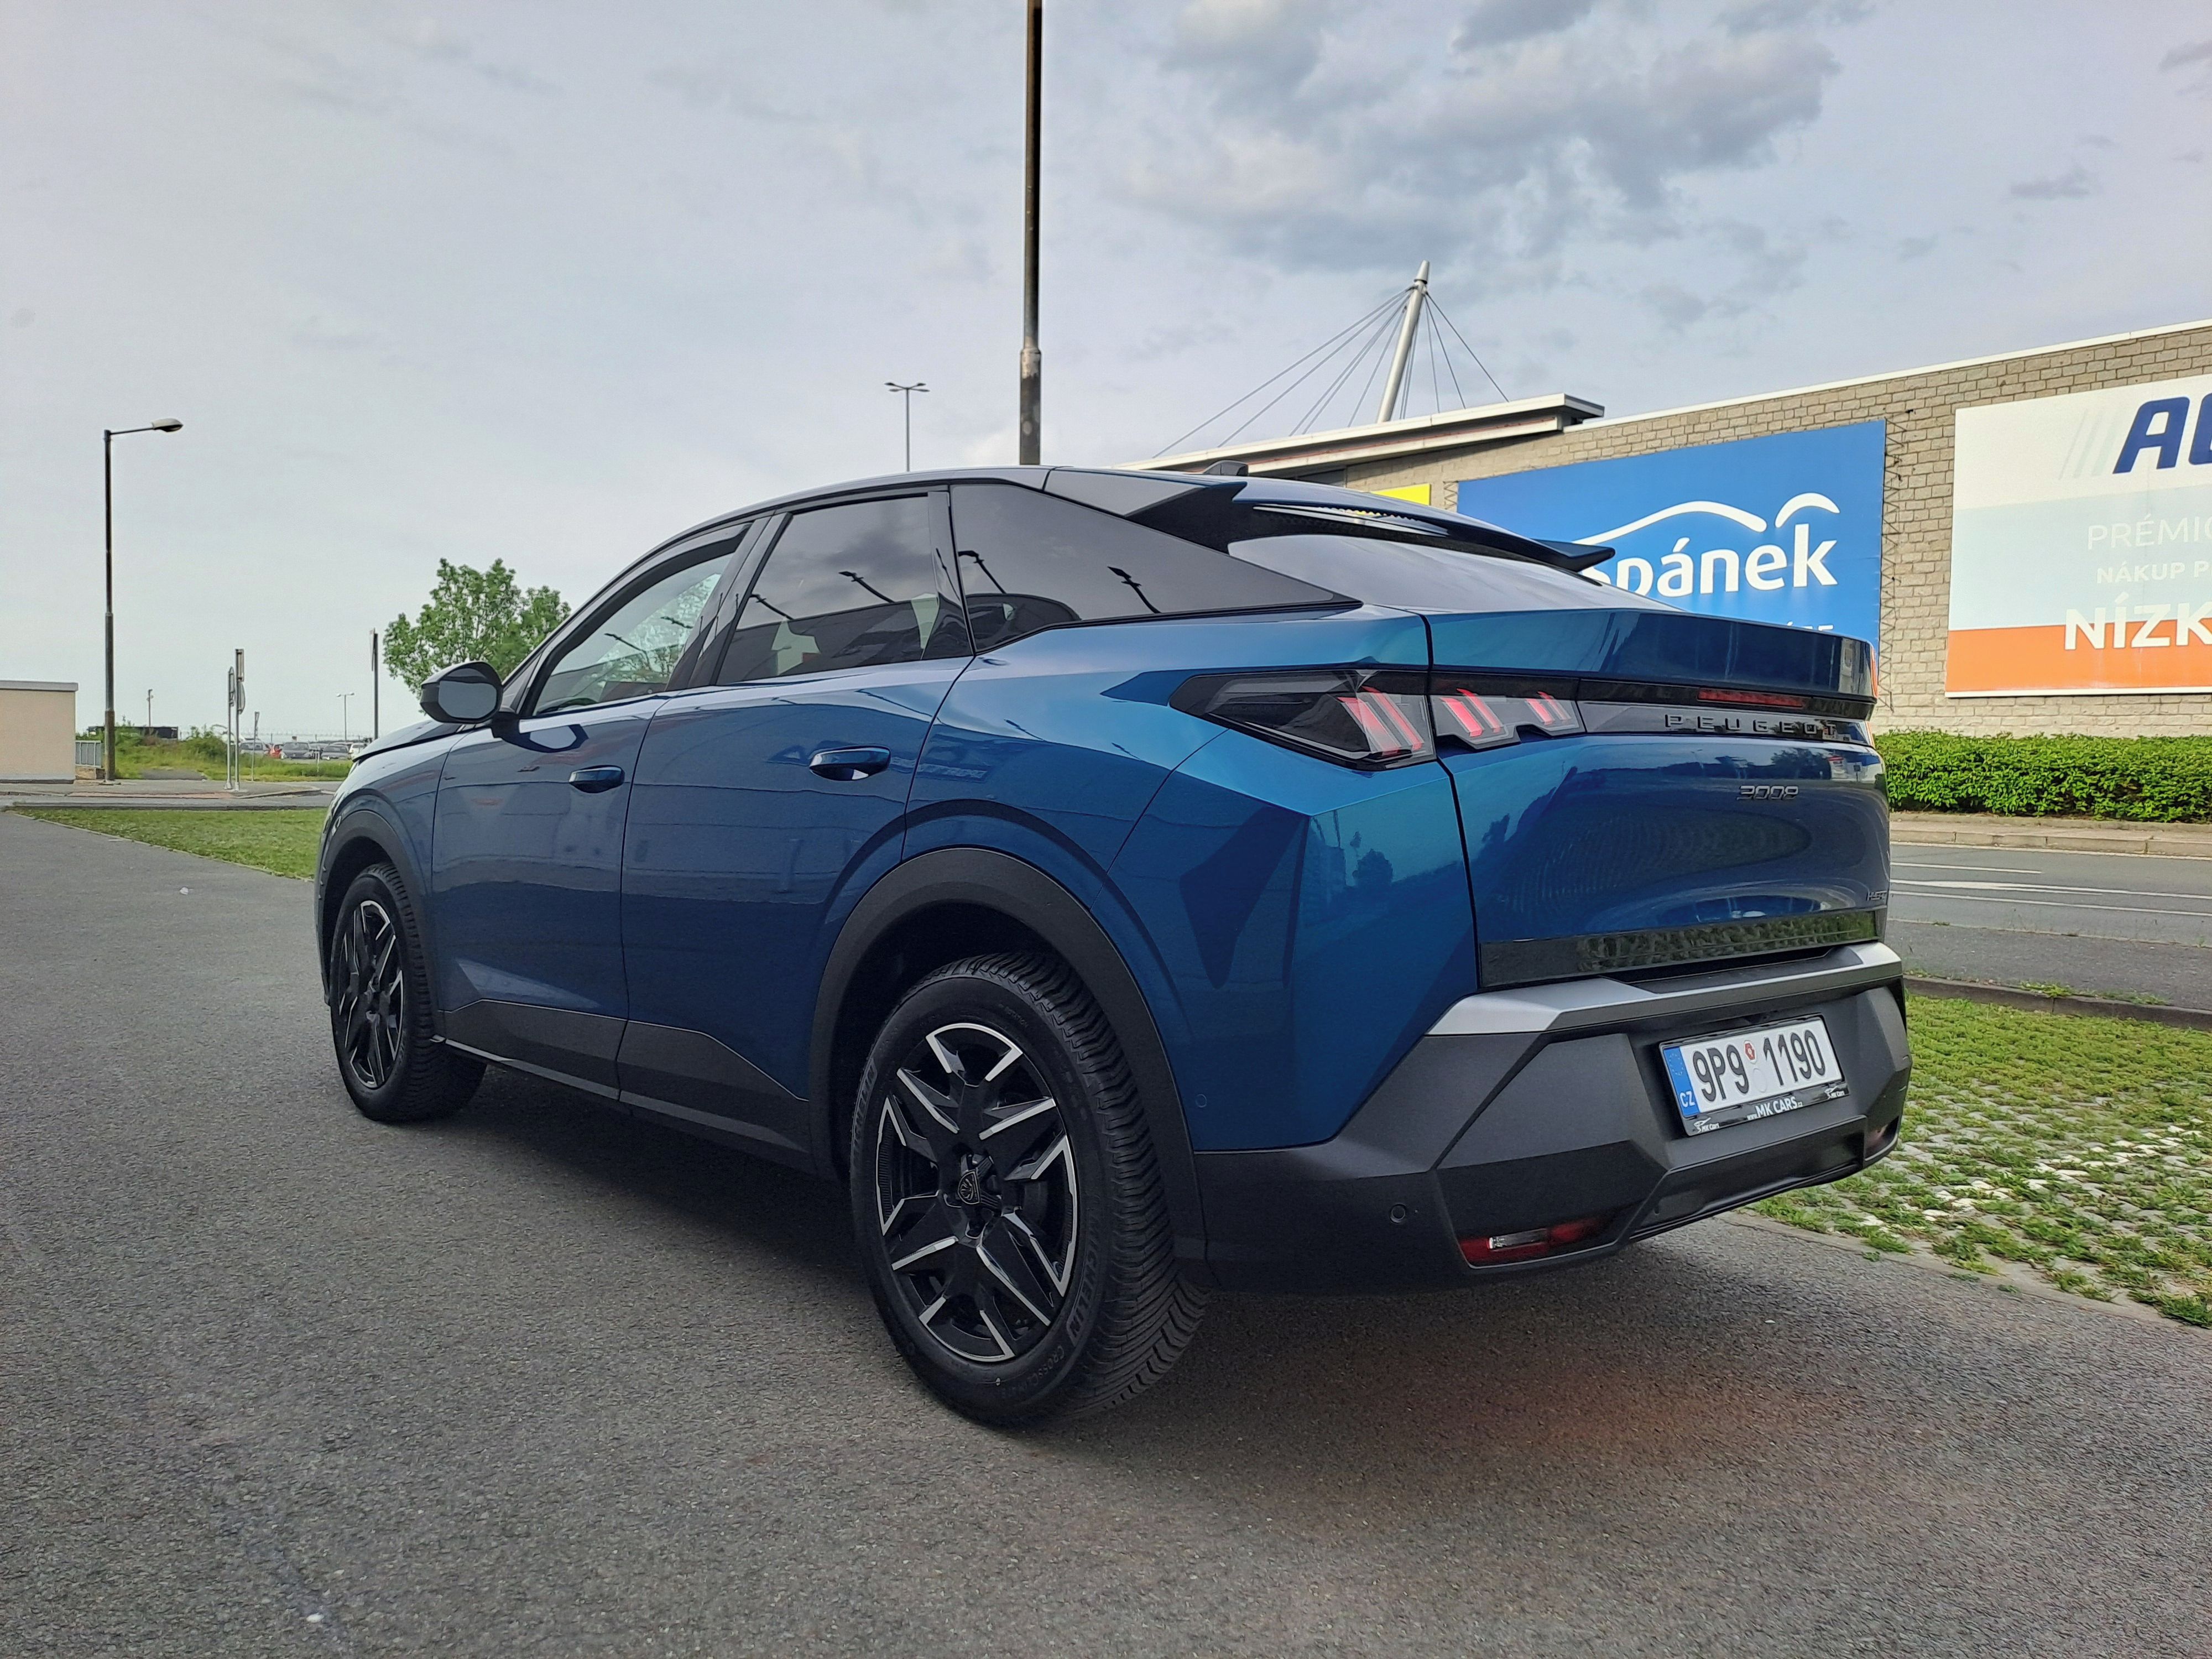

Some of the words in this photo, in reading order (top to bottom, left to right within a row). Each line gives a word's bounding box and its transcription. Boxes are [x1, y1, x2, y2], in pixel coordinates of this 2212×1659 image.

[2096, 560, 2185, 584] NÁKUP
[2194, 560, 2212, 578] P
[1665, 713, 1837, 735] PEUGEOT
[1736, 785, 1798, 800] 3008
[1693, 1045, 1749, 1102] 9P9
[1763, 1030, 1825, 1087] 1190
[1679, 1091, 1696, 1108] CZ
